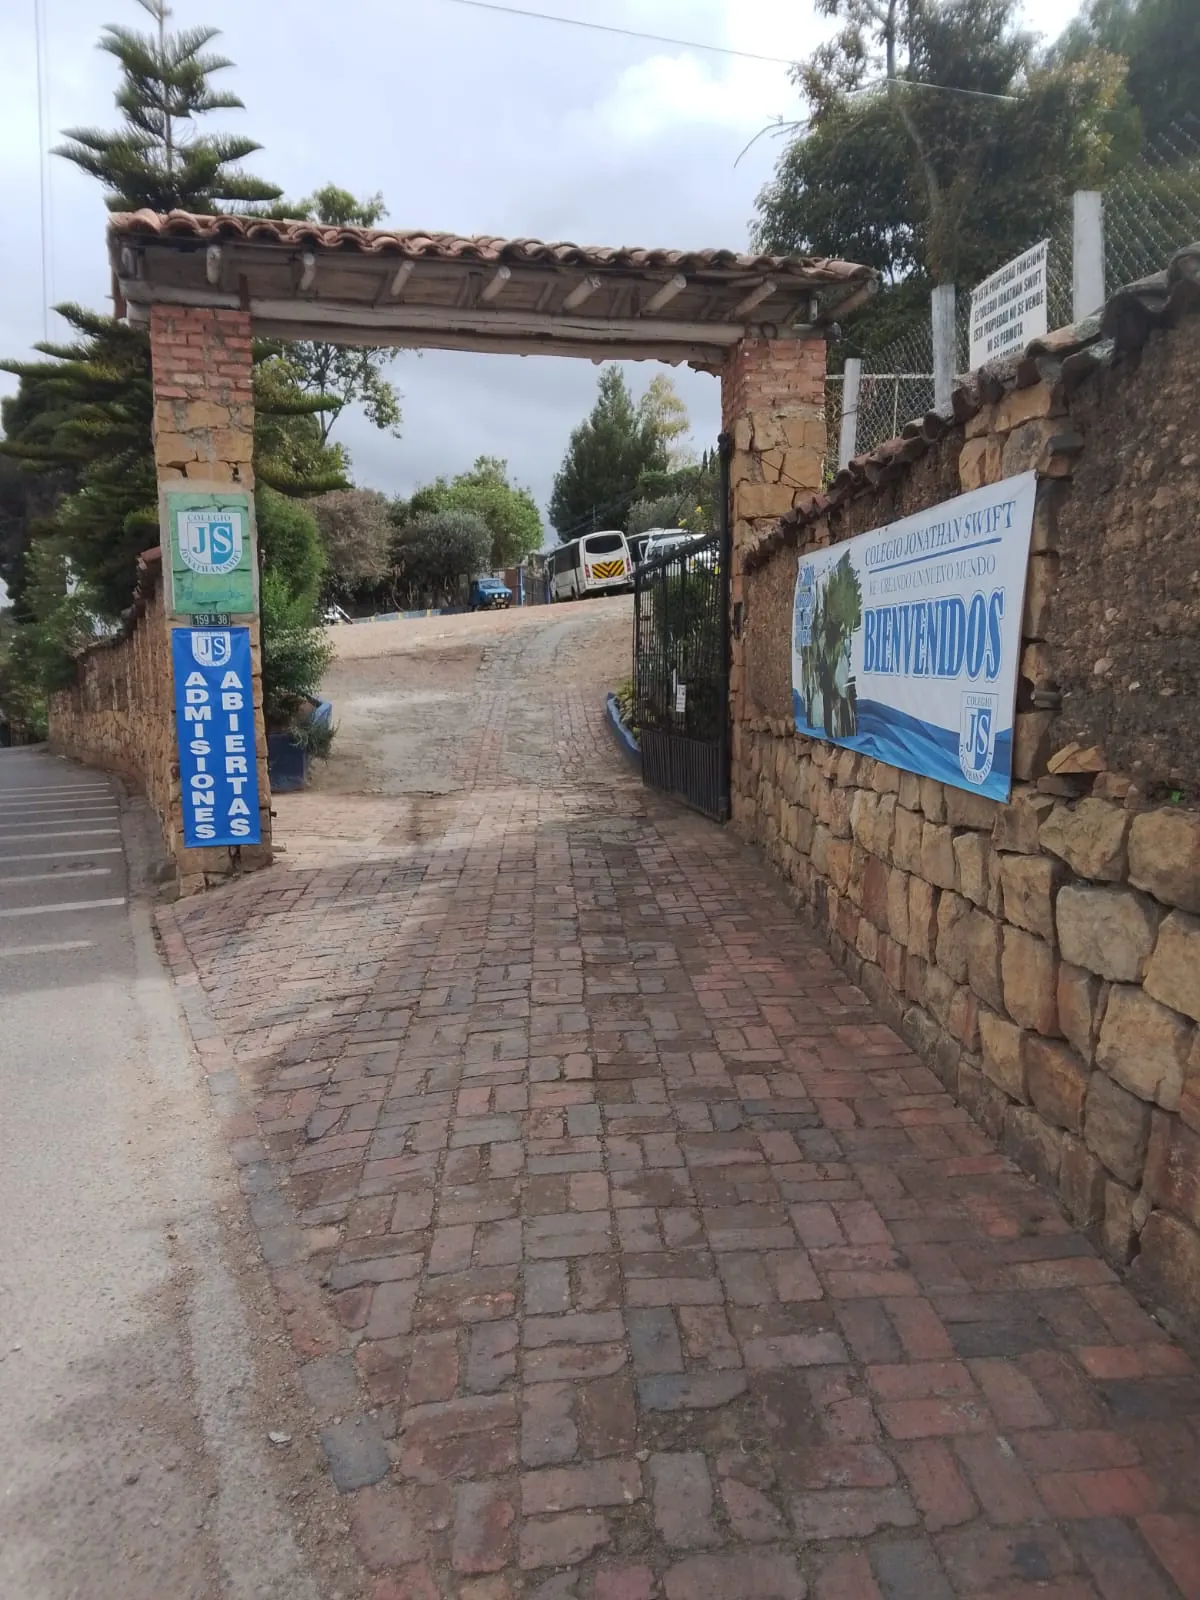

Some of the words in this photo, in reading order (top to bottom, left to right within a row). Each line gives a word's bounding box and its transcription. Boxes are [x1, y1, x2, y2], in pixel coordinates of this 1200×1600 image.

[998, 282, 1022, 307] JONATHAN
[1023, 269, 1041, 292] SWIFT
[974, 325, 983, 341] ESTA
[983, 310, 1008, 335] PROPIEDAD
[1017, 300, 1024, 316] SE
[1025, 289, 1043, 312] VENDE
[993, 334, 999, 349] SE
[1000, 321, 1023, 345] PERMUTA
[187, 512, 231, 522] COLEGIO
[192, 525, 232, 554] JS
[865, 537, 904, 567] COLEGIO
[903, 517, 963, 555] JONATHAN
[964, 501, 1016, 538] SWIFT
[955, 554, 996, 581] MUNDO
[195, 615, 209, 625] 159
[863, 586, 1005, 682] BIENVENIDOS
[201, 636, 226, 656] JS
[966, 695, 992, 706] COLEGIO
[966, 714, 990, 755] JS
[184, 671, 216, 839] ADMISIONES
[220, 671, 251, 837] ABIERTAS
